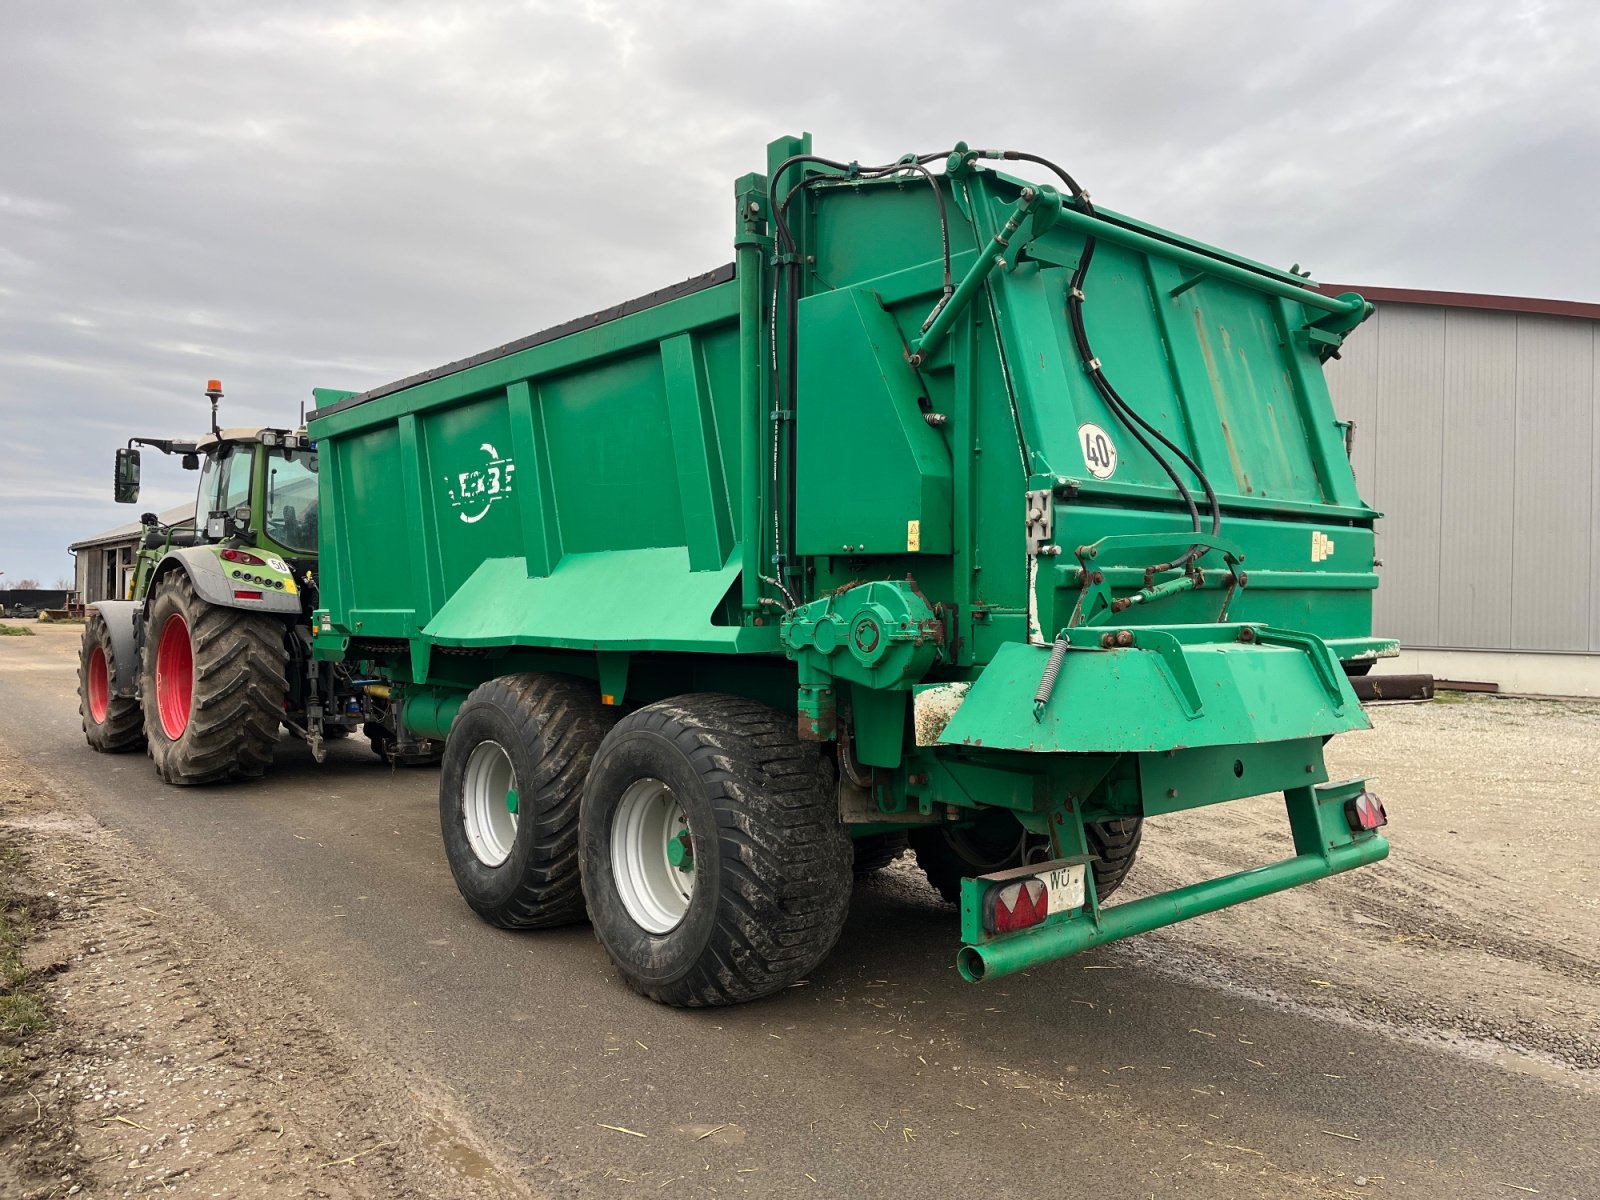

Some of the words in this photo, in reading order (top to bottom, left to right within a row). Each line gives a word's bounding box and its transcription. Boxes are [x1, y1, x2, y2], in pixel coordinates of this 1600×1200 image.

[1085, 433, 1110, 468] 40
[271, 559, 288, 572] 50
[1050, 867, 1070, 891] WÜ
